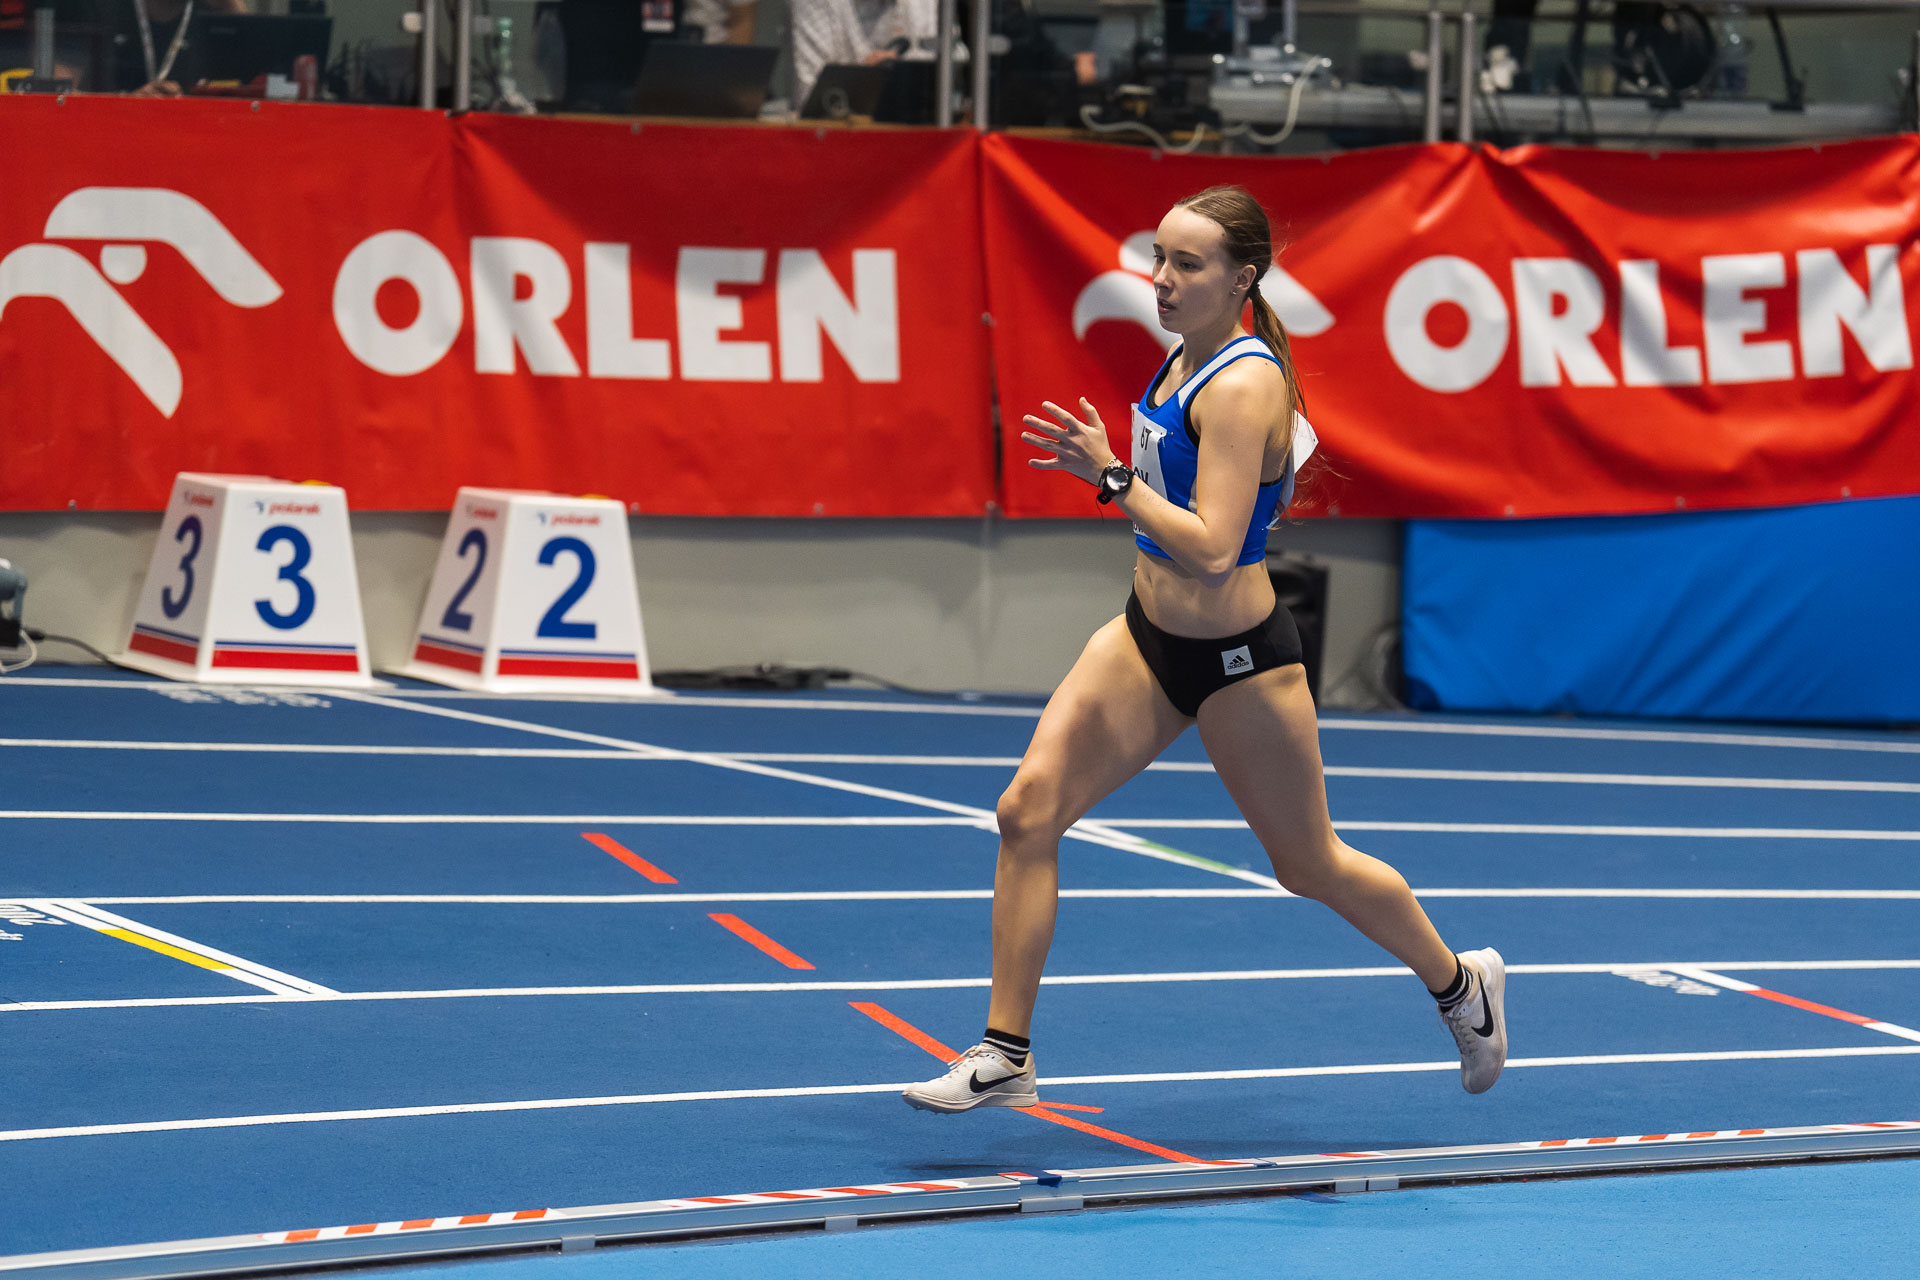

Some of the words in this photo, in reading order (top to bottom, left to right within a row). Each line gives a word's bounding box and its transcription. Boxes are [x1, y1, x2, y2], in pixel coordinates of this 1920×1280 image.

[333, 230, 900, 384] ORLEN
[1385, 245, 1913, 392] ORLEN
[161, 515, 203, 619] 3
[254, 524, 316, 630] 3
[441, 528, 488, 632] 2
[536, 535, 597, 640] 2
[1227, 660, 1250, 670] adidas
